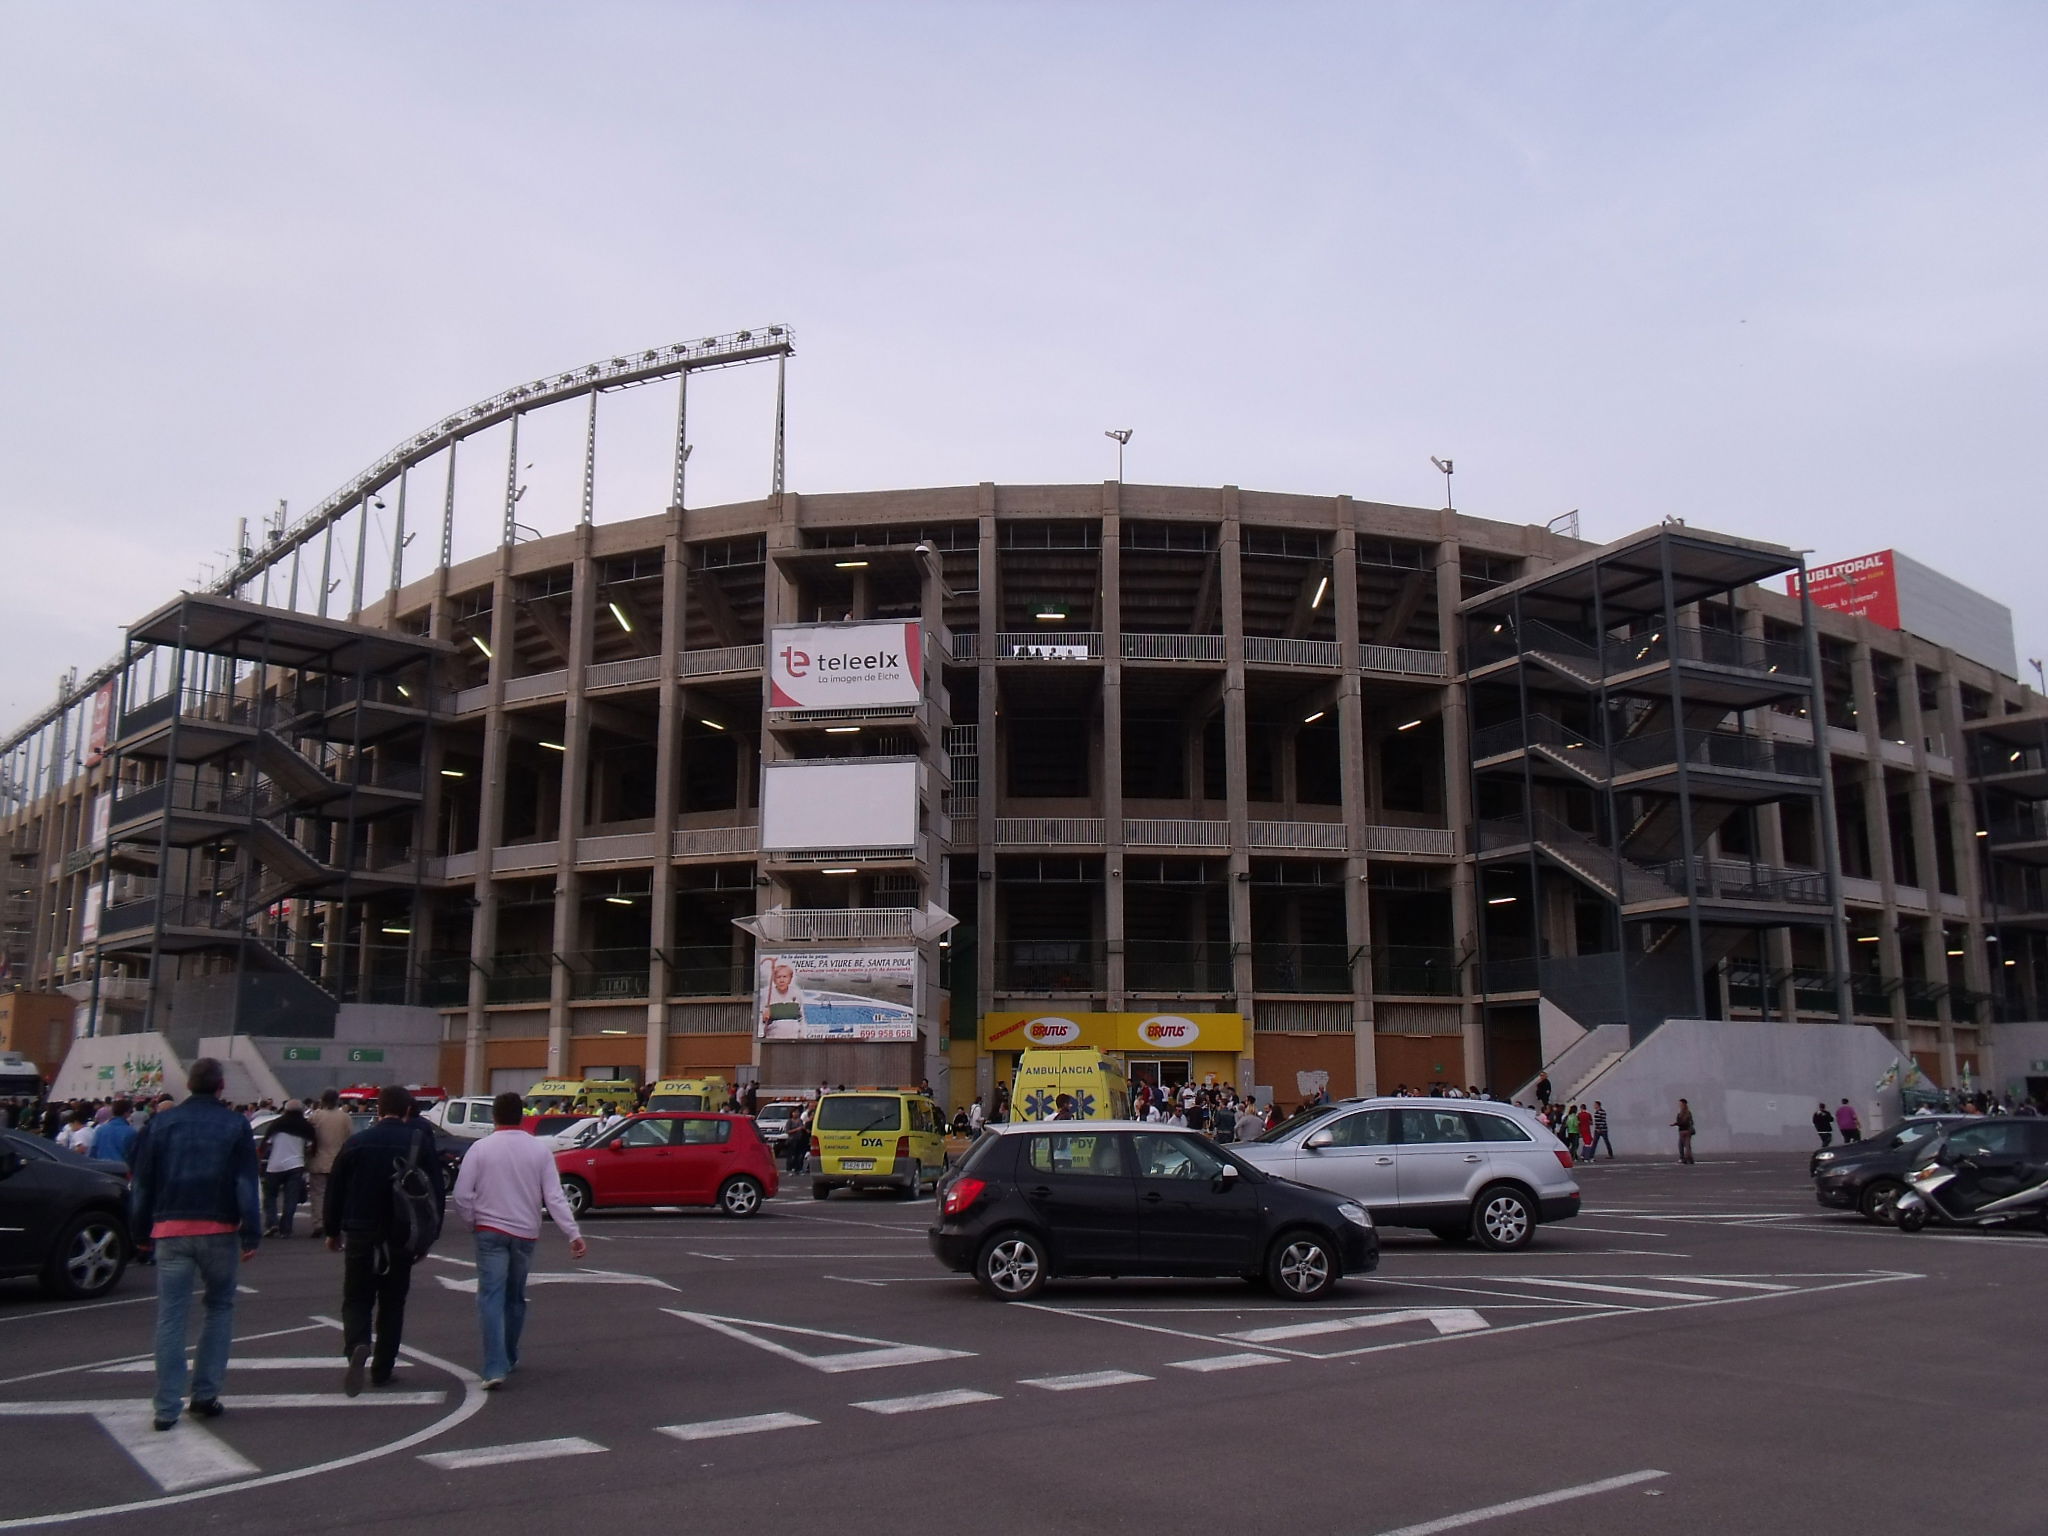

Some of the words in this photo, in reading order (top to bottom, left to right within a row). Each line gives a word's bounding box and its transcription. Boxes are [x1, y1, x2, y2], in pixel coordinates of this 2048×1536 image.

[817, 651, 899, 671] teleelx
[818, 675, 828, 684] La
[830, 674, 863, 684] imagen
[864, 673, 876, 682] de
[877, 672, 900, 681] Elche
[818, 959, 829, 968] PA
[830, 959, 854, 968] VIURE
[867, 958, 892, 968] SANTA
[860, 1029, 876, 1038] 699
[1031, 1024, 1068, 1038] BRUTUS
[1147, 1024, 1186, 1038] BRUTUS
[289, 1048, 298, 1059] 6
[353, 1051, 361, 1061] 6
[1025, 1066, 1094, 1075] AMBULANCIA
[542, 1083, 567, 1091] DYA
[664, 1083, 692, 1091] DYA
[861, 1138, 883, 1147] DYA
